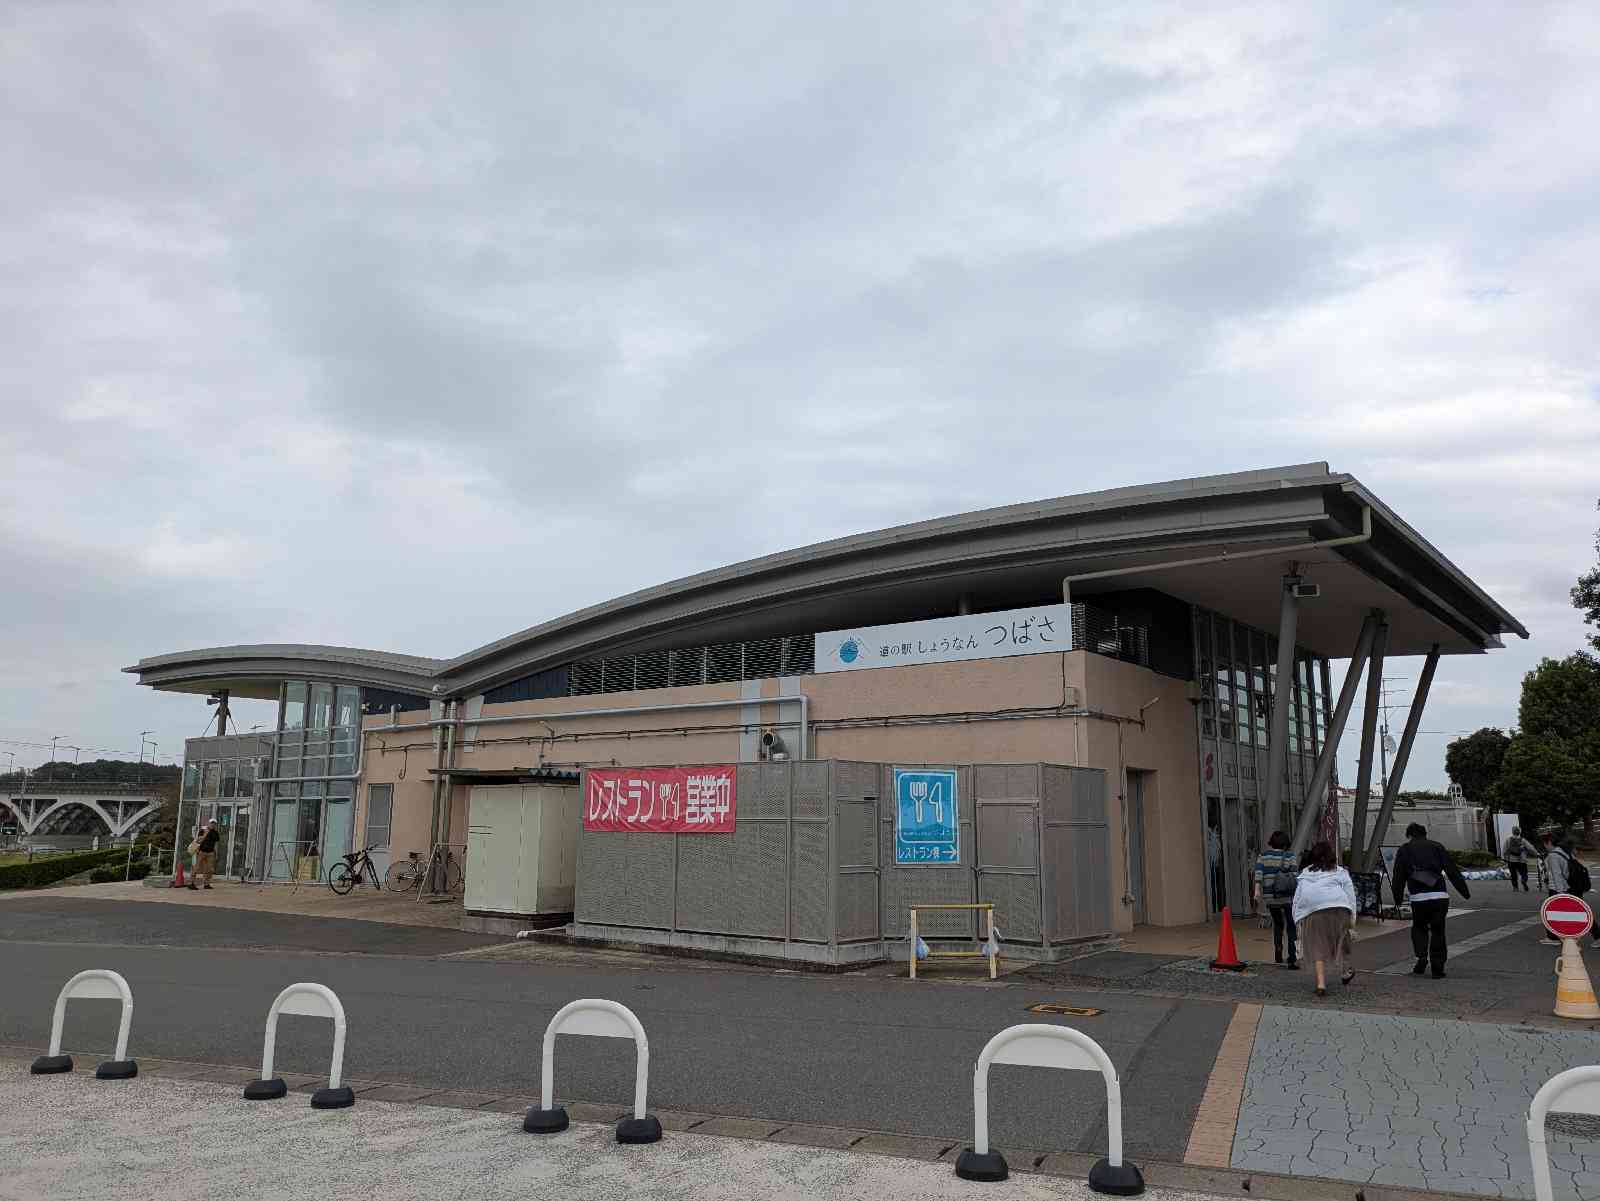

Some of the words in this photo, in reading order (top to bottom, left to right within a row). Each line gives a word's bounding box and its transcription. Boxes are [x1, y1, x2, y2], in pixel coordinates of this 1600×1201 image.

[917, 635, 978, 654] しょうなん
[985, 615, 1056, 646] つばさ
[589, 778, 656, 823] レストラン
[685, 773, 731, 824] 営業中
